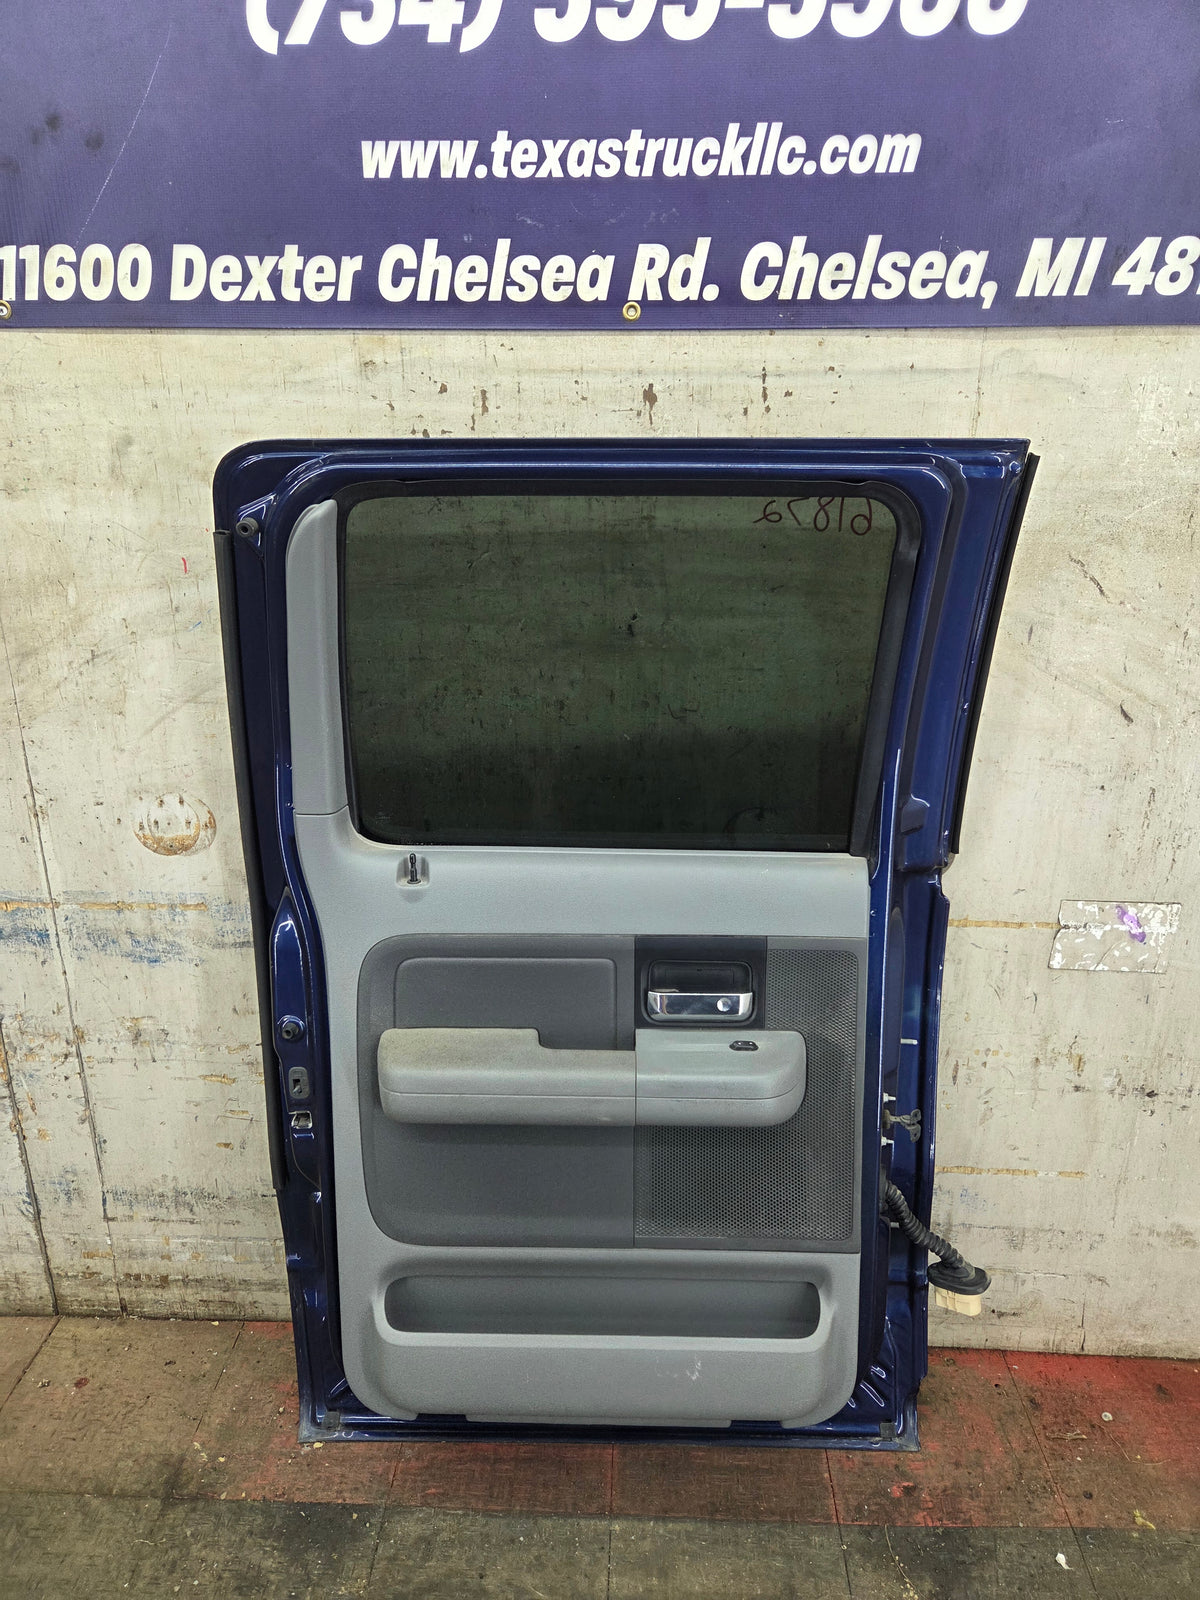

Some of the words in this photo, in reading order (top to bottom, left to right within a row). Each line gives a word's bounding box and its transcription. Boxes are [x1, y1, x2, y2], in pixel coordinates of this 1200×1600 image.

[361, 122, 921, 178] www.texastruckllc.com
[0, 244, 153, 302] 11600
[170, 244, 363, 302] Dexter
[378, 239, 616, 302] Chelsea
[628, 237, 719, 302] Rd.
[741, 235, 997, 310] Chelsea,
[1015, 237, 1108, 297] MI
[1111, 235, 1200, 297] 48
